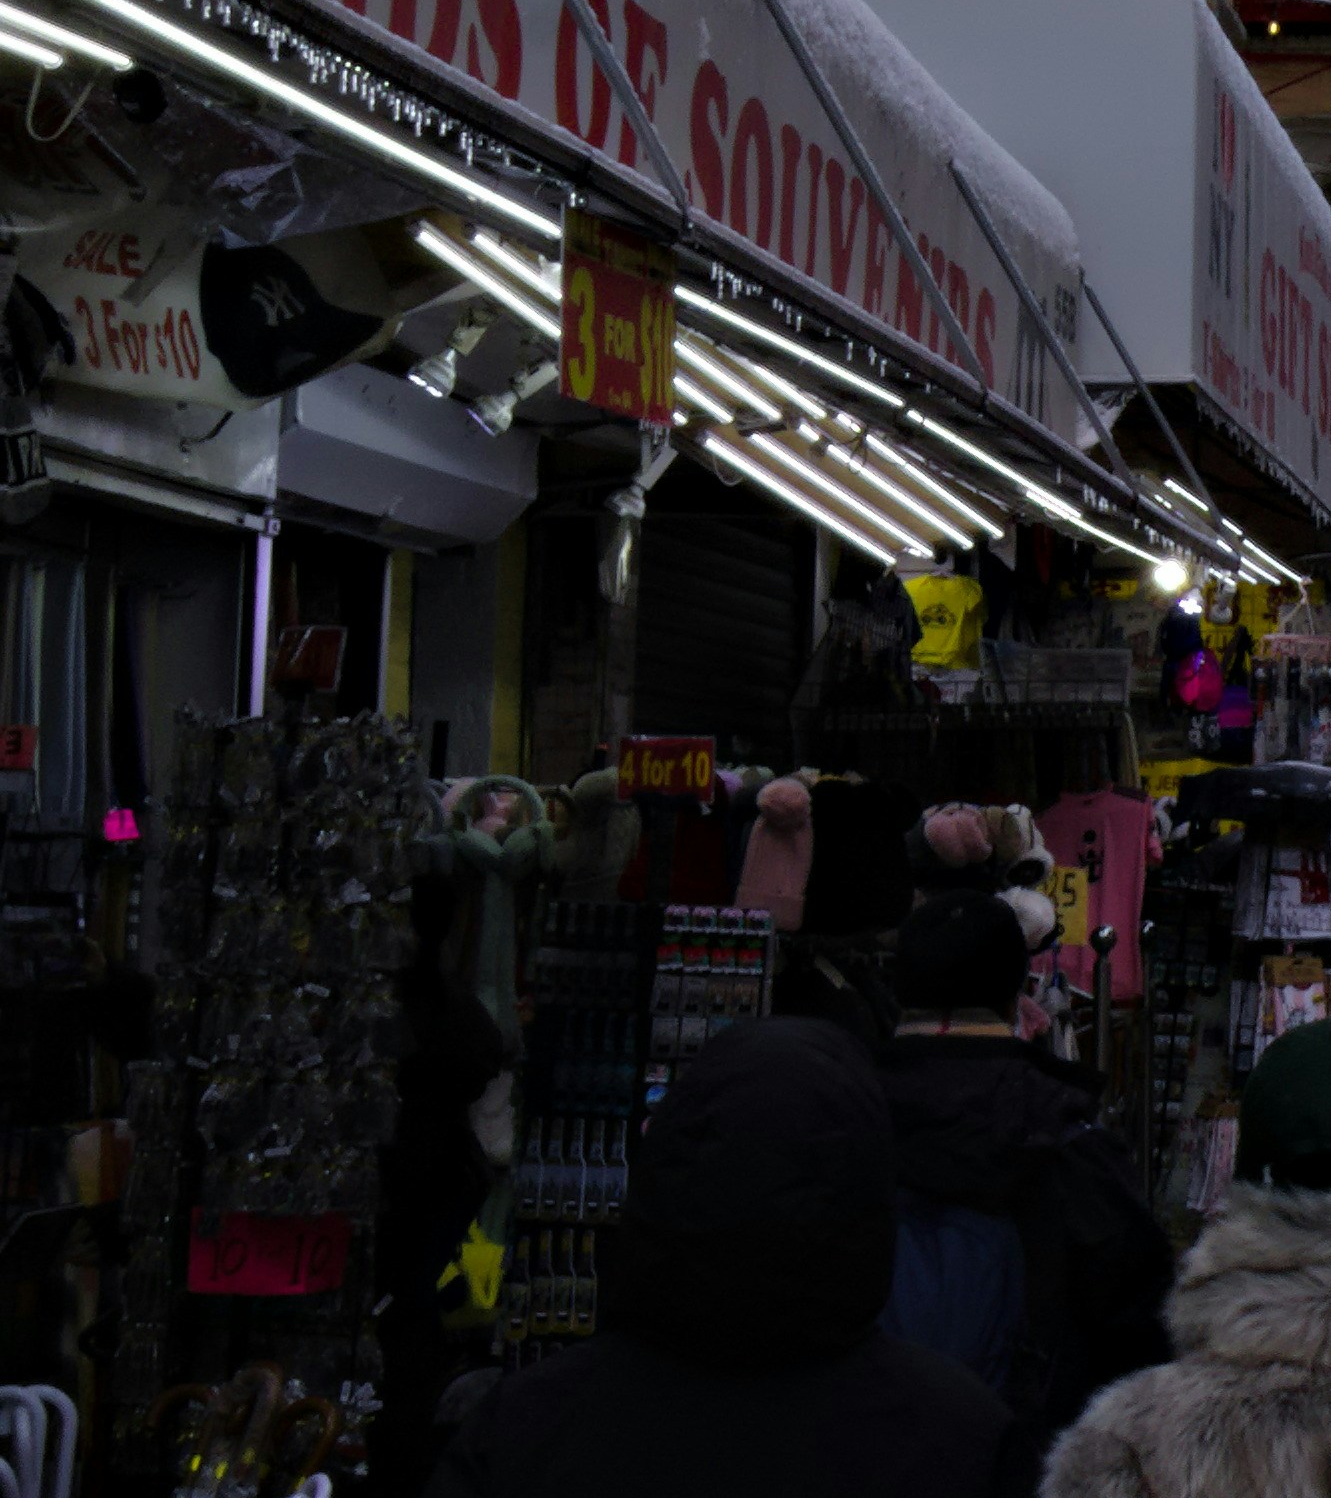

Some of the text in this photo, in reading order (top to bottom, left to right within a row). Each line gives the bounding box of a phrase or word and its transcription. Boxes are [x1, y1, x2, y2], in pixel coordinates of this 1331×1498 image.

[63, 230, 144, 278] SALE
[684, 58, 998, 389] SOUVENIRS
[75, 296, 101, 369] 3
[568, 267, 674, 417] 3 FOR $10
[1259, 246, 1314, 417] GIFT
[641, 751, 678, 786] for
[681, 749, 710, 788] 10
